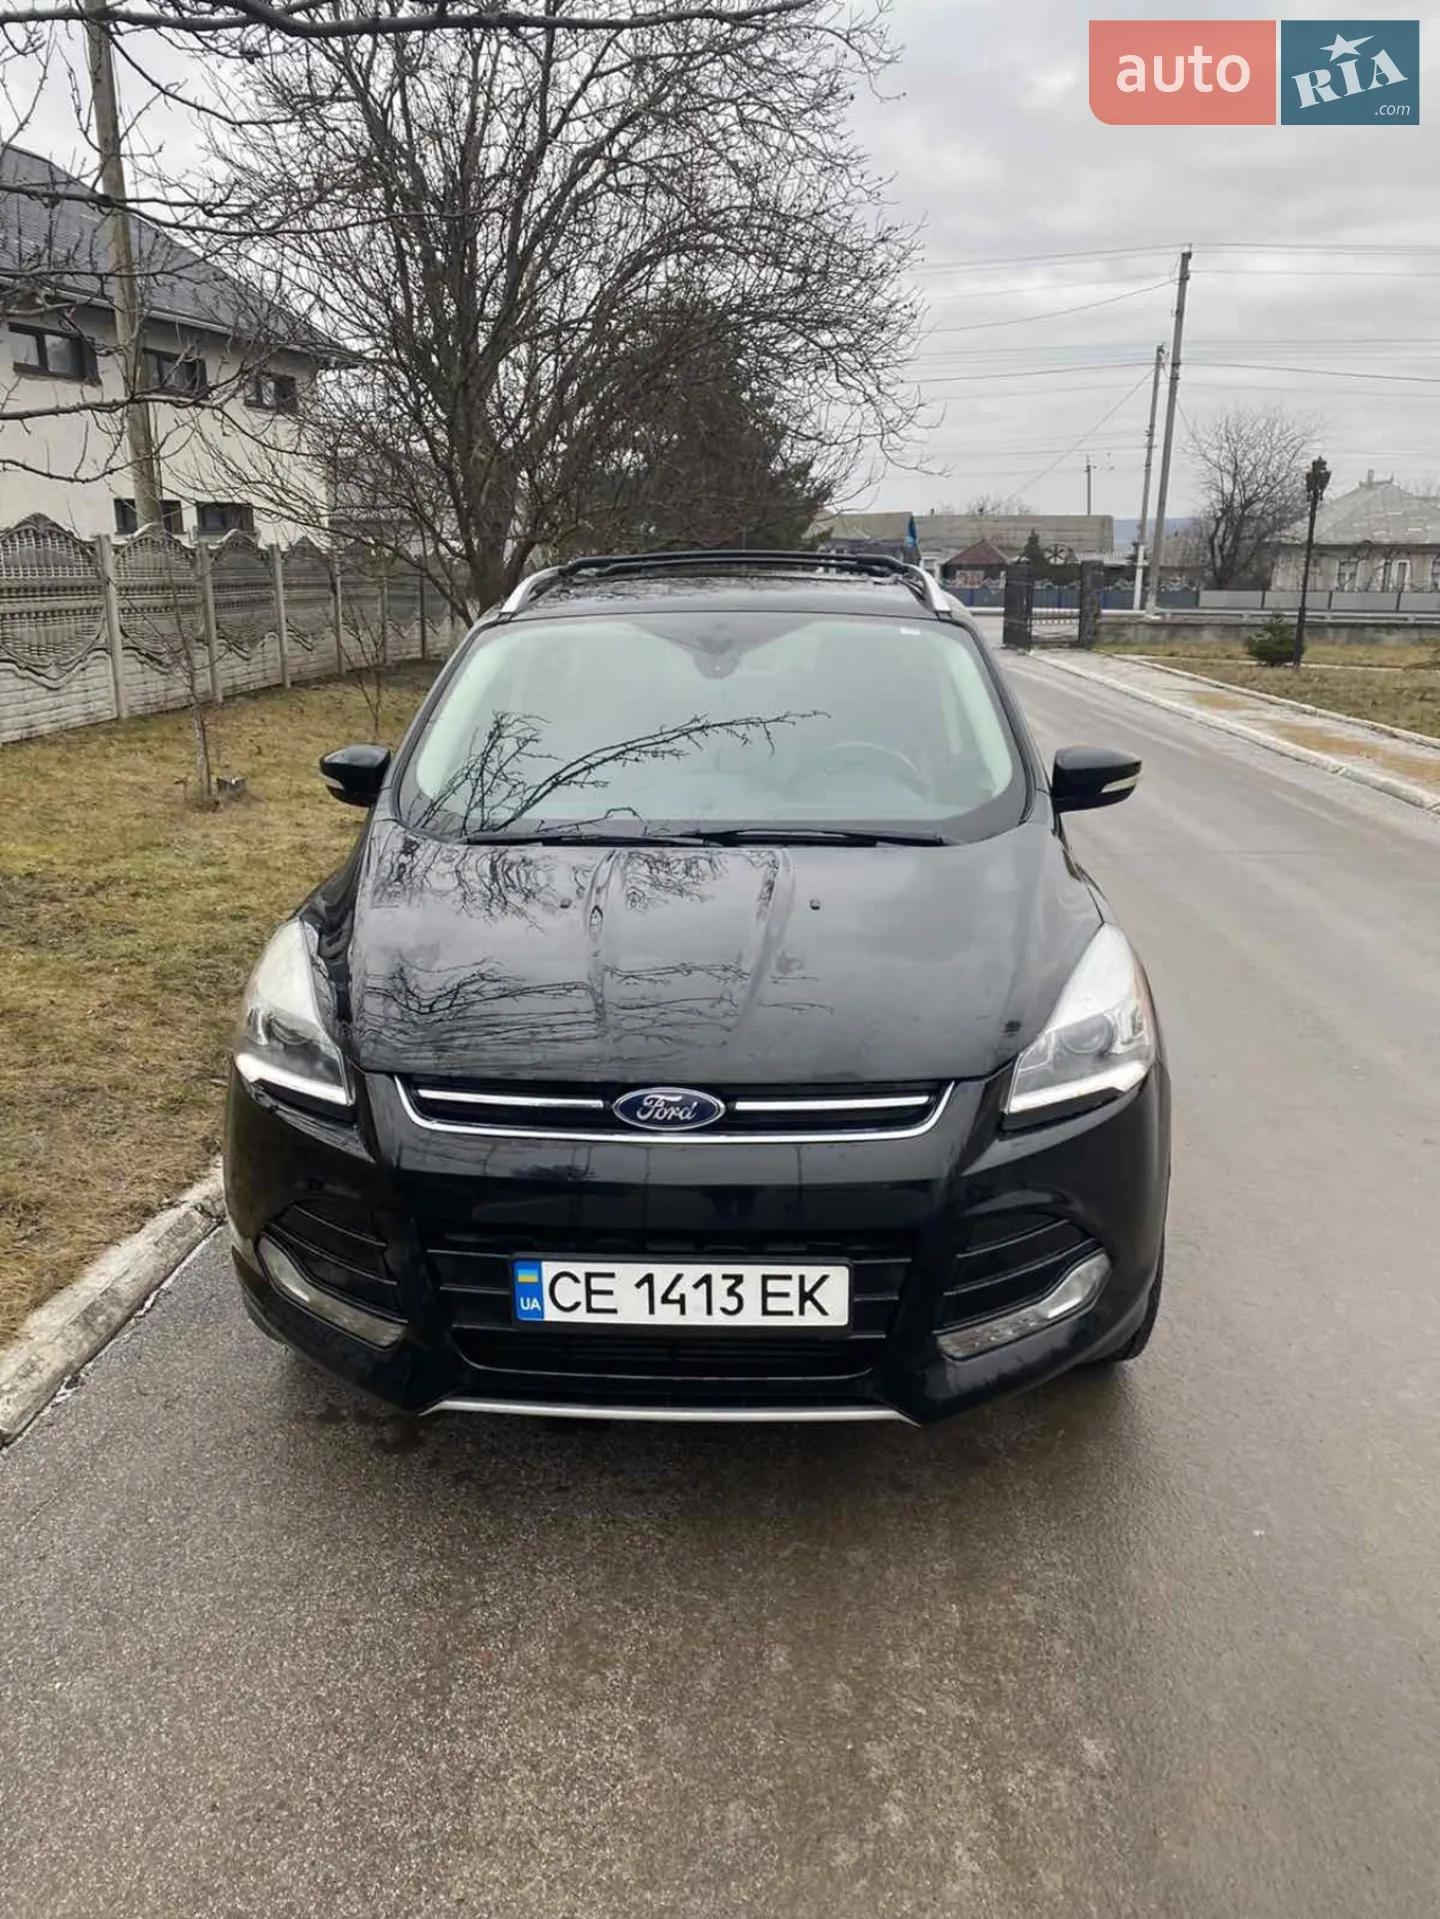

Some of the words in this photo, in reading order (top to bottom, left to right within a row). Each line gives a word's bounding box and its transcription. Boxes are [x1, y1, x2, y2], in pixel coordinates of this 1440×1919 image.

[636, 1094, 698, 1120] Ford
[520, 1296, 541, 1311] UA
[548, 1271, 618, 1315] CE
[634, 1272, 744, 1317] 1413
[760, 1274, 830, 1317] EK
